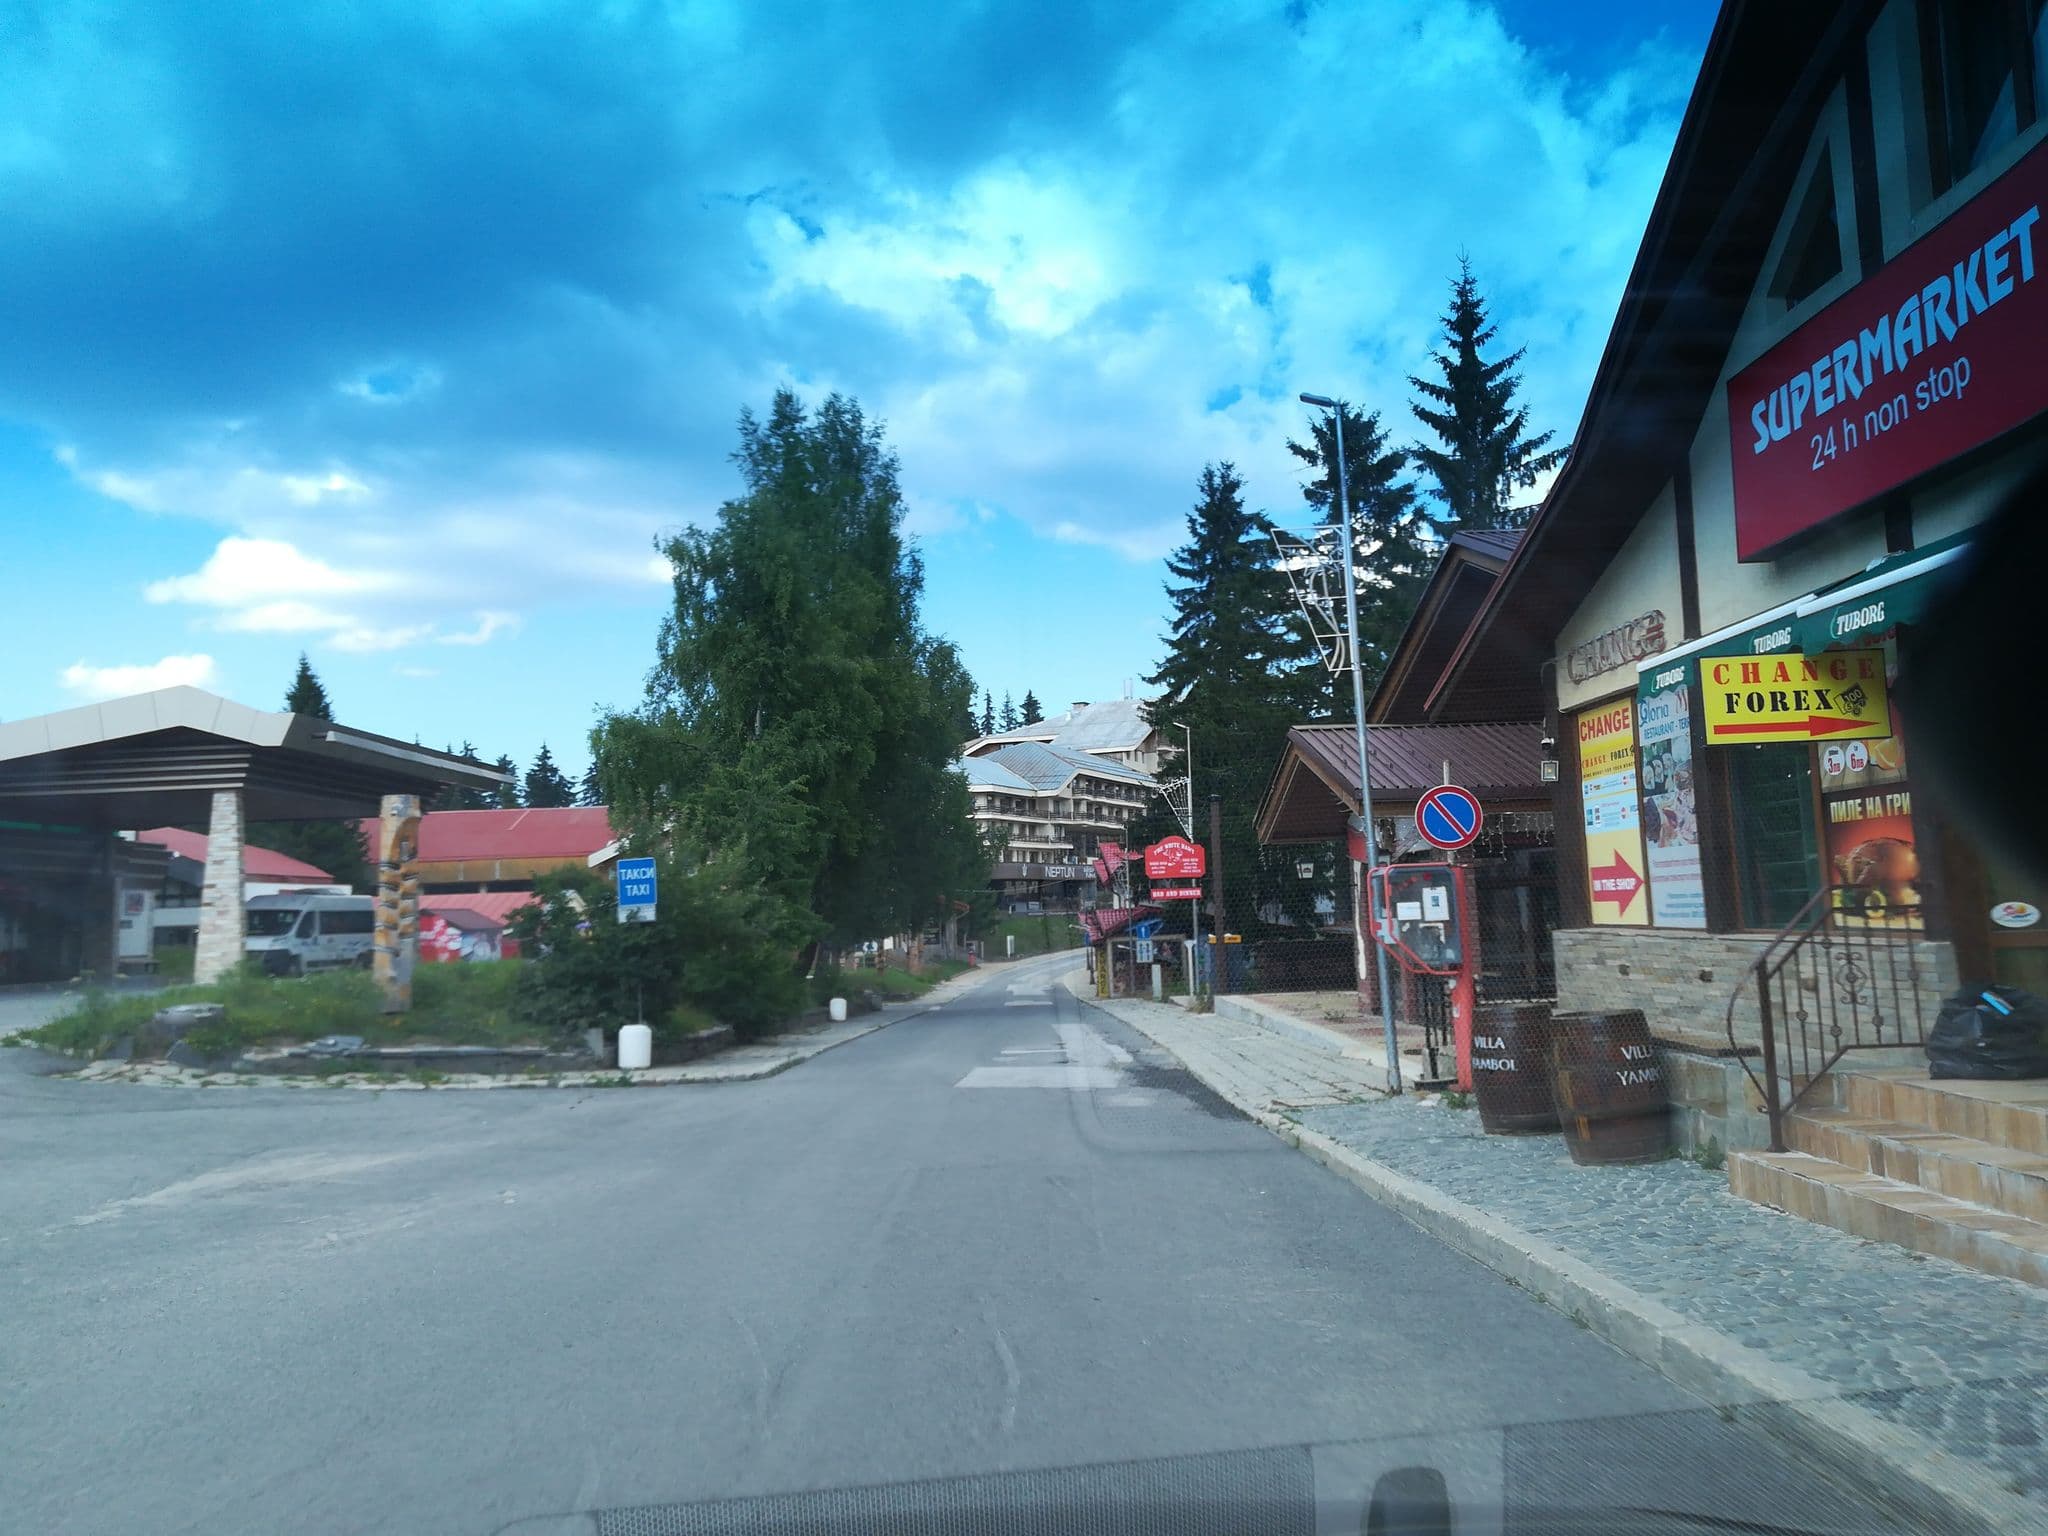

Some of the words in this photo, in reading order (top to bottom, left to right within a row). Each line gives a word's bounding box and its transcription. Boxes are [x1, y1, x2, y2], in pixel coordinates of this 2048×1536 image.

[1750, 204, 2040, 455] SUPERMARKET
[1810, 427, 1837, 472] 24
[1843, 418, 1859, 453] h
[1864, 393, 1909, 442] non
[1914, 355, 1971, 412] stop
[1836, 601, 1885, 636] TUBORG
[1753, 627, 1792, 654] TUBORG
[1656, 666, 1686, 690] TUBORG
[1713, 657, 1875, 685] CHANGE
[1725, 688, 1834, 714] FOREX
[1580, 707, 1631, 742] CHANGE
[1610, 747, 1629, 761] FOREX
[1830, 798, 1863, 823] ПИЛЕ
[1865, 796, 1883, 819] НА
[620, 867, 655, 880] ТАКСИ
[1044, 866, 1075, 878] NEPTUN
[624, 884, 650, 896] TAXI
[1474, 1036, 1506, 1050] VILLA
[1472, 1057, 1519, 1072] AMBOL
